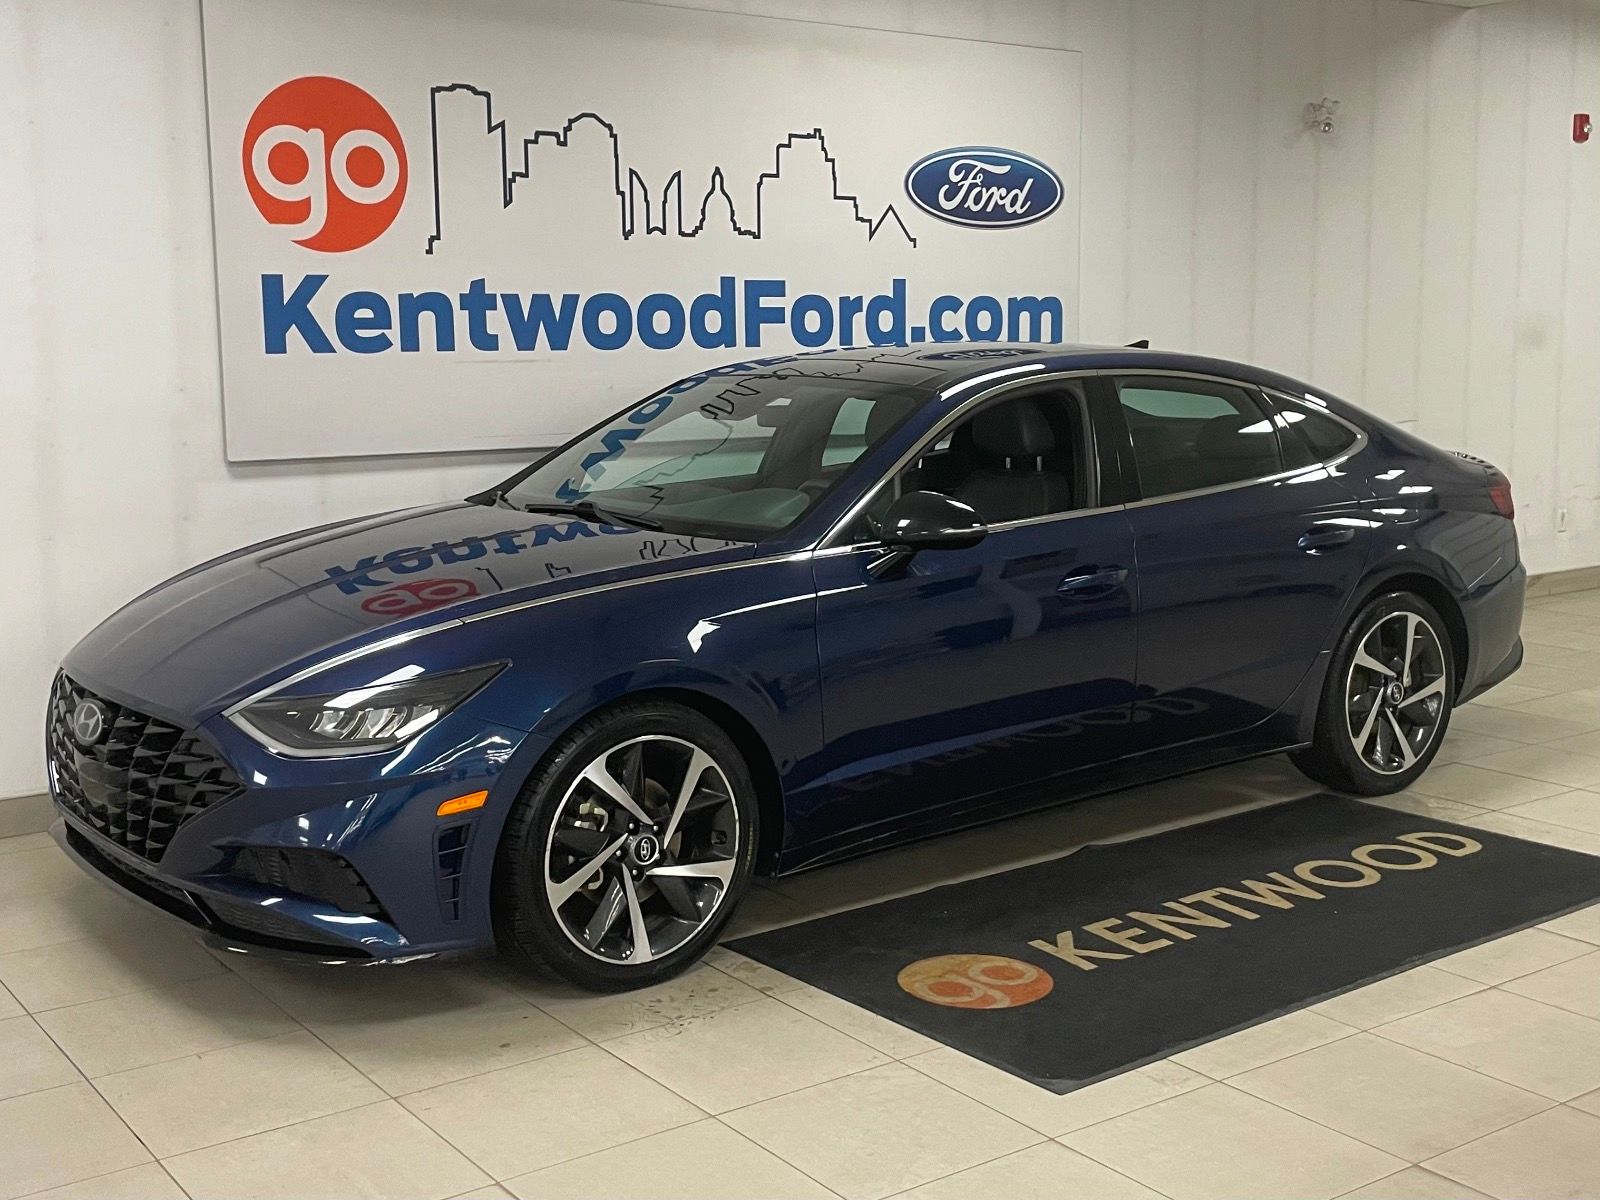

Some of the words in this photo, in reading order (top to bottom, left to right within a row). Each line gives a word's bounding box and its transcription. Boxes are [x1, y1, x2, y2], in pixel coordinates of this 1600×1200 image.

[252, 124, 400, 241] go
[938, 159, 1034, 214] Ford
[260, 273, 1063, 354] KentwoodFord.com
[1027, 830, 1483, 971] KENTWOOD
[914, 960, 1039, 1009] go
